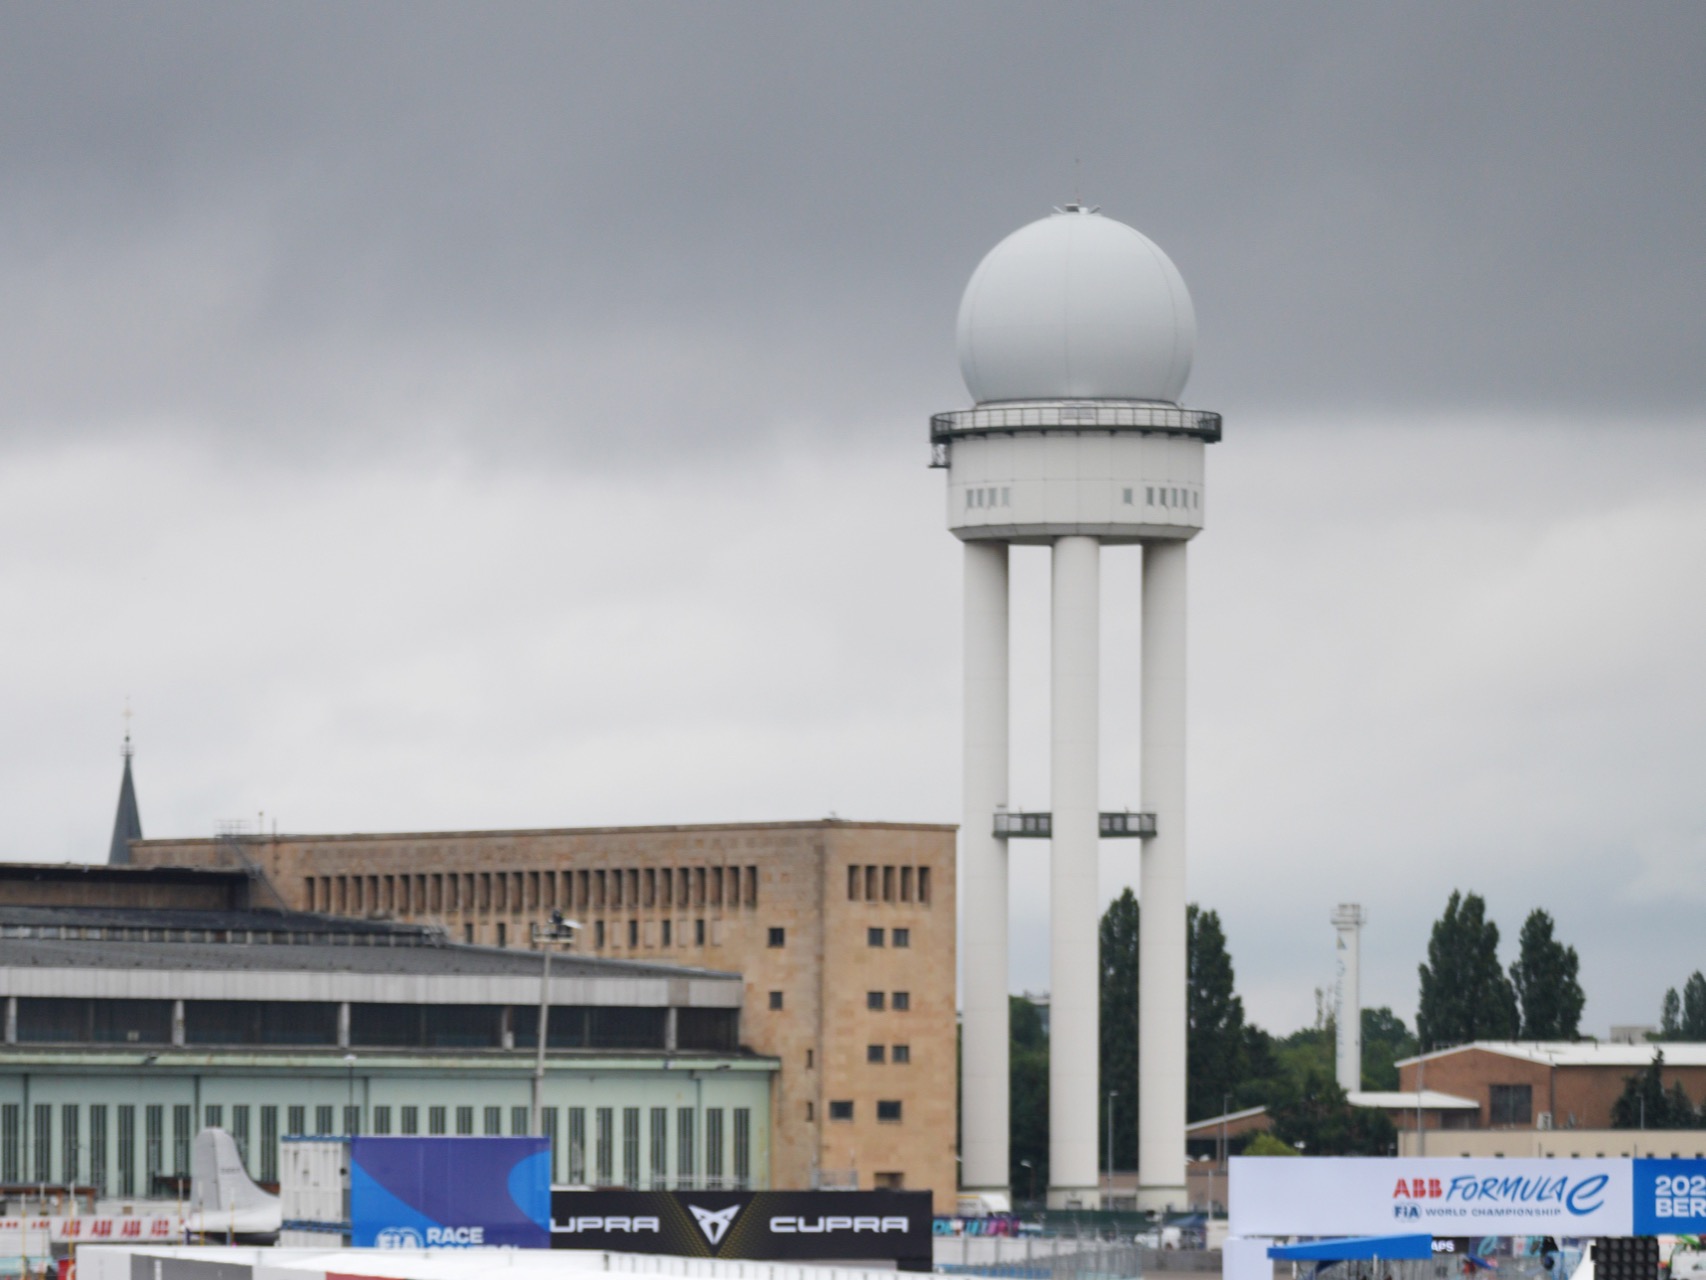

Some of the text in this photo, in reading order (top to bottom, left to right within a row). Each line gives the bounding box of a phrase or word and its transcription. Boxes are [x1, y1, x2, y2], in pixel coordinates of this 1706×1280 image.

[1393, 1178, 1442, 1199] ABB
[1446, 1175, 1568, 1201] FORMULA
[1655, 1175, 1706, 1197] 202
[1425, 1208, 1467, 1217] WORLD
[1471, 1208, 1561, 1217] CHAMPIONSHIP
[1655, 1197, 1706, 1218] BER
[550, 1216, 909, 1233] UPRA CUPRA
[426, 1227, 484, 1244] RACE
[1431, 1240, 1454, 1252] APS
